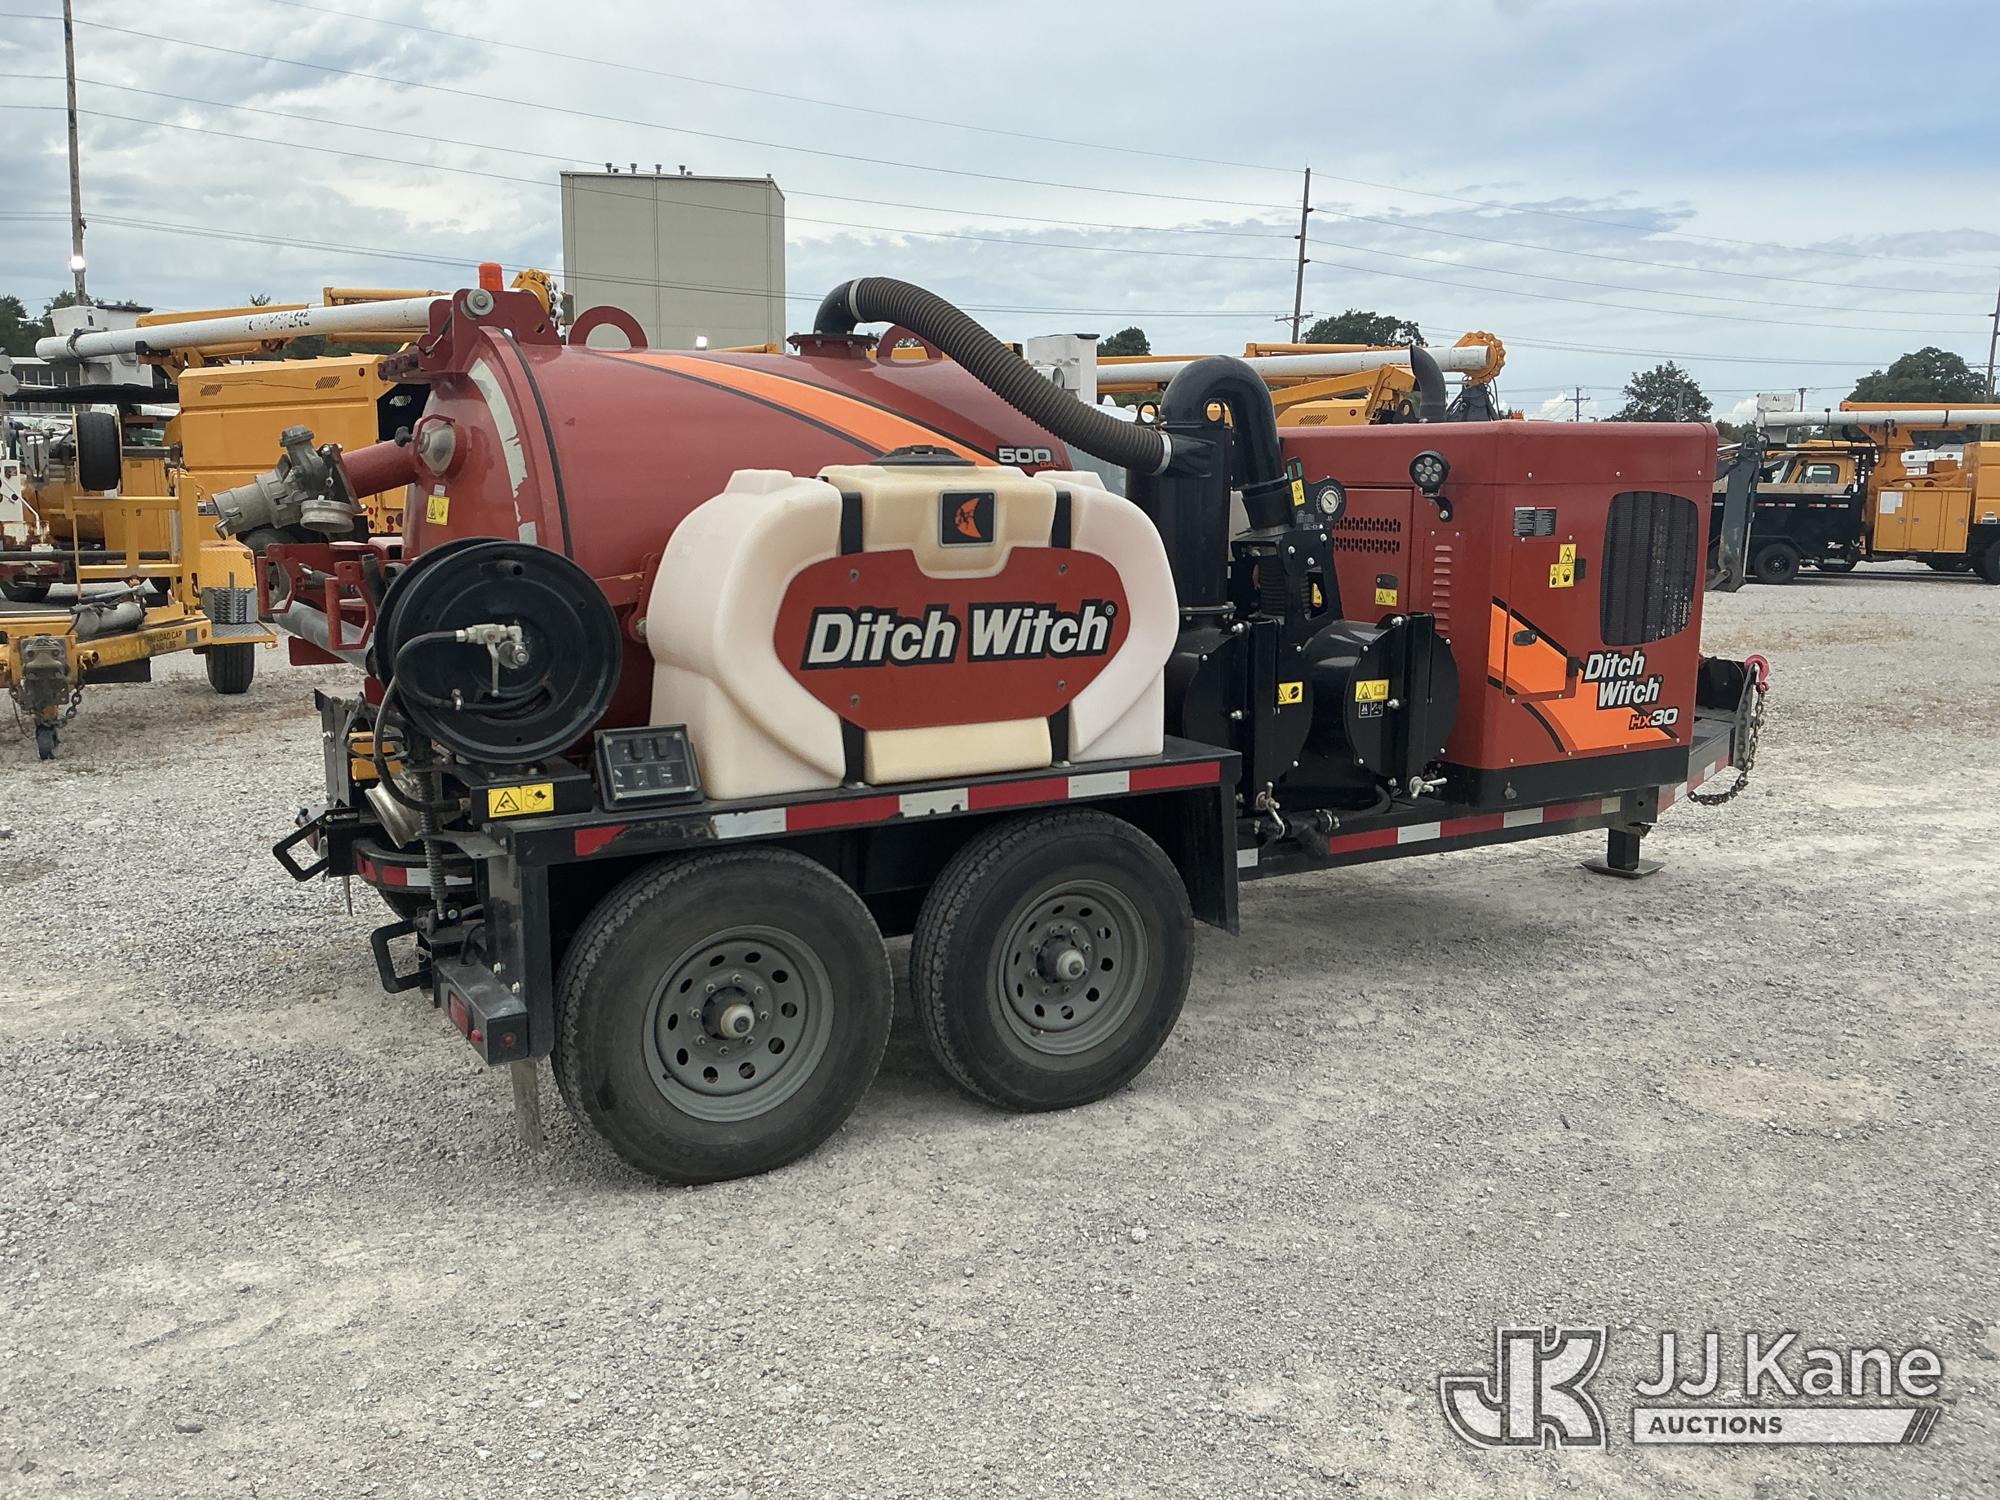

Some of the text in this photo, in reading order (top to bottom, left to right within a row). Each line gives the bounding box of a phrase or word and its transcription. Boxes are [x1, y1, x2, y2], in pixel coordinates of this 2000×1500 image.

[998, 448, 1051, 463] 500
[807, 610, 956, 664] Ditch
[1584, 651, 1645, 680] Ditch
[1630, 708, 1678, 729] HX30
